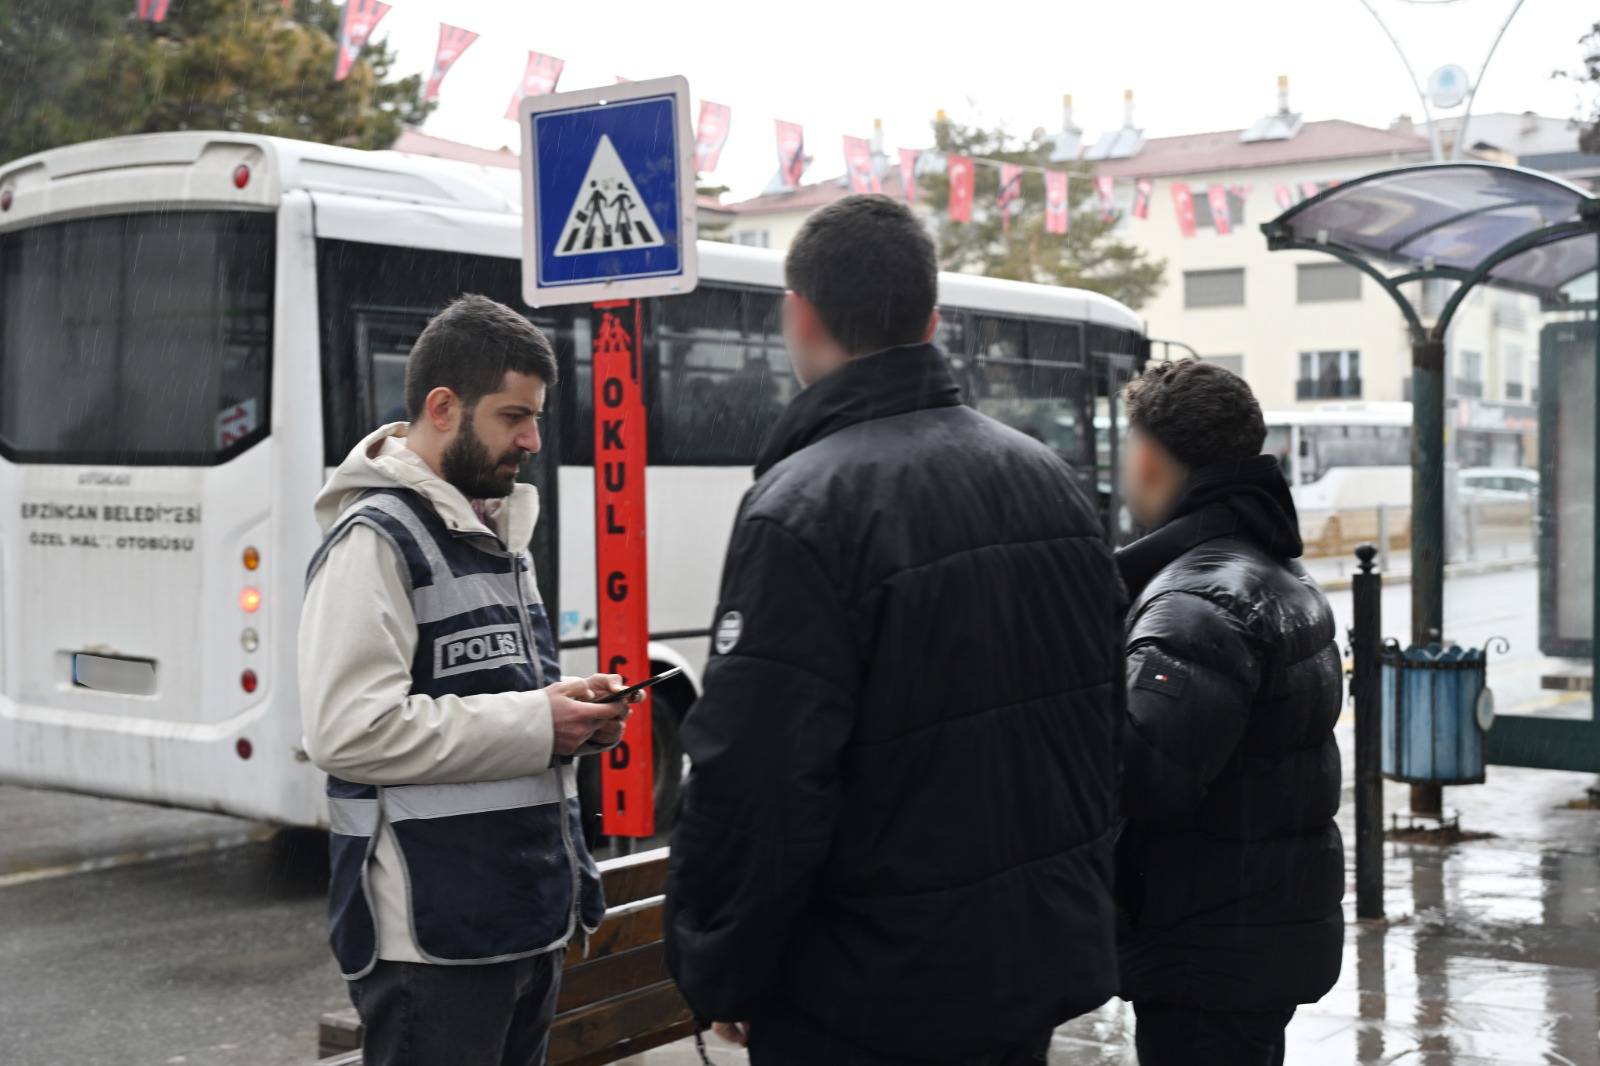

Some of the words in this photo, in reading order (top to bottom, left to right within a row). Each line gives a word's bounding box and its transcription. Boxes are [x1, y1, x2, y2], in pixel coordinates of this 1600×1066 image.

[602, 377, 627, 535] OKUL
[21, 501, 98, 521] ERZİNCAN
[29, 532, 65, 547] ÖZEL
[69, 535, 112, 549] HAL
